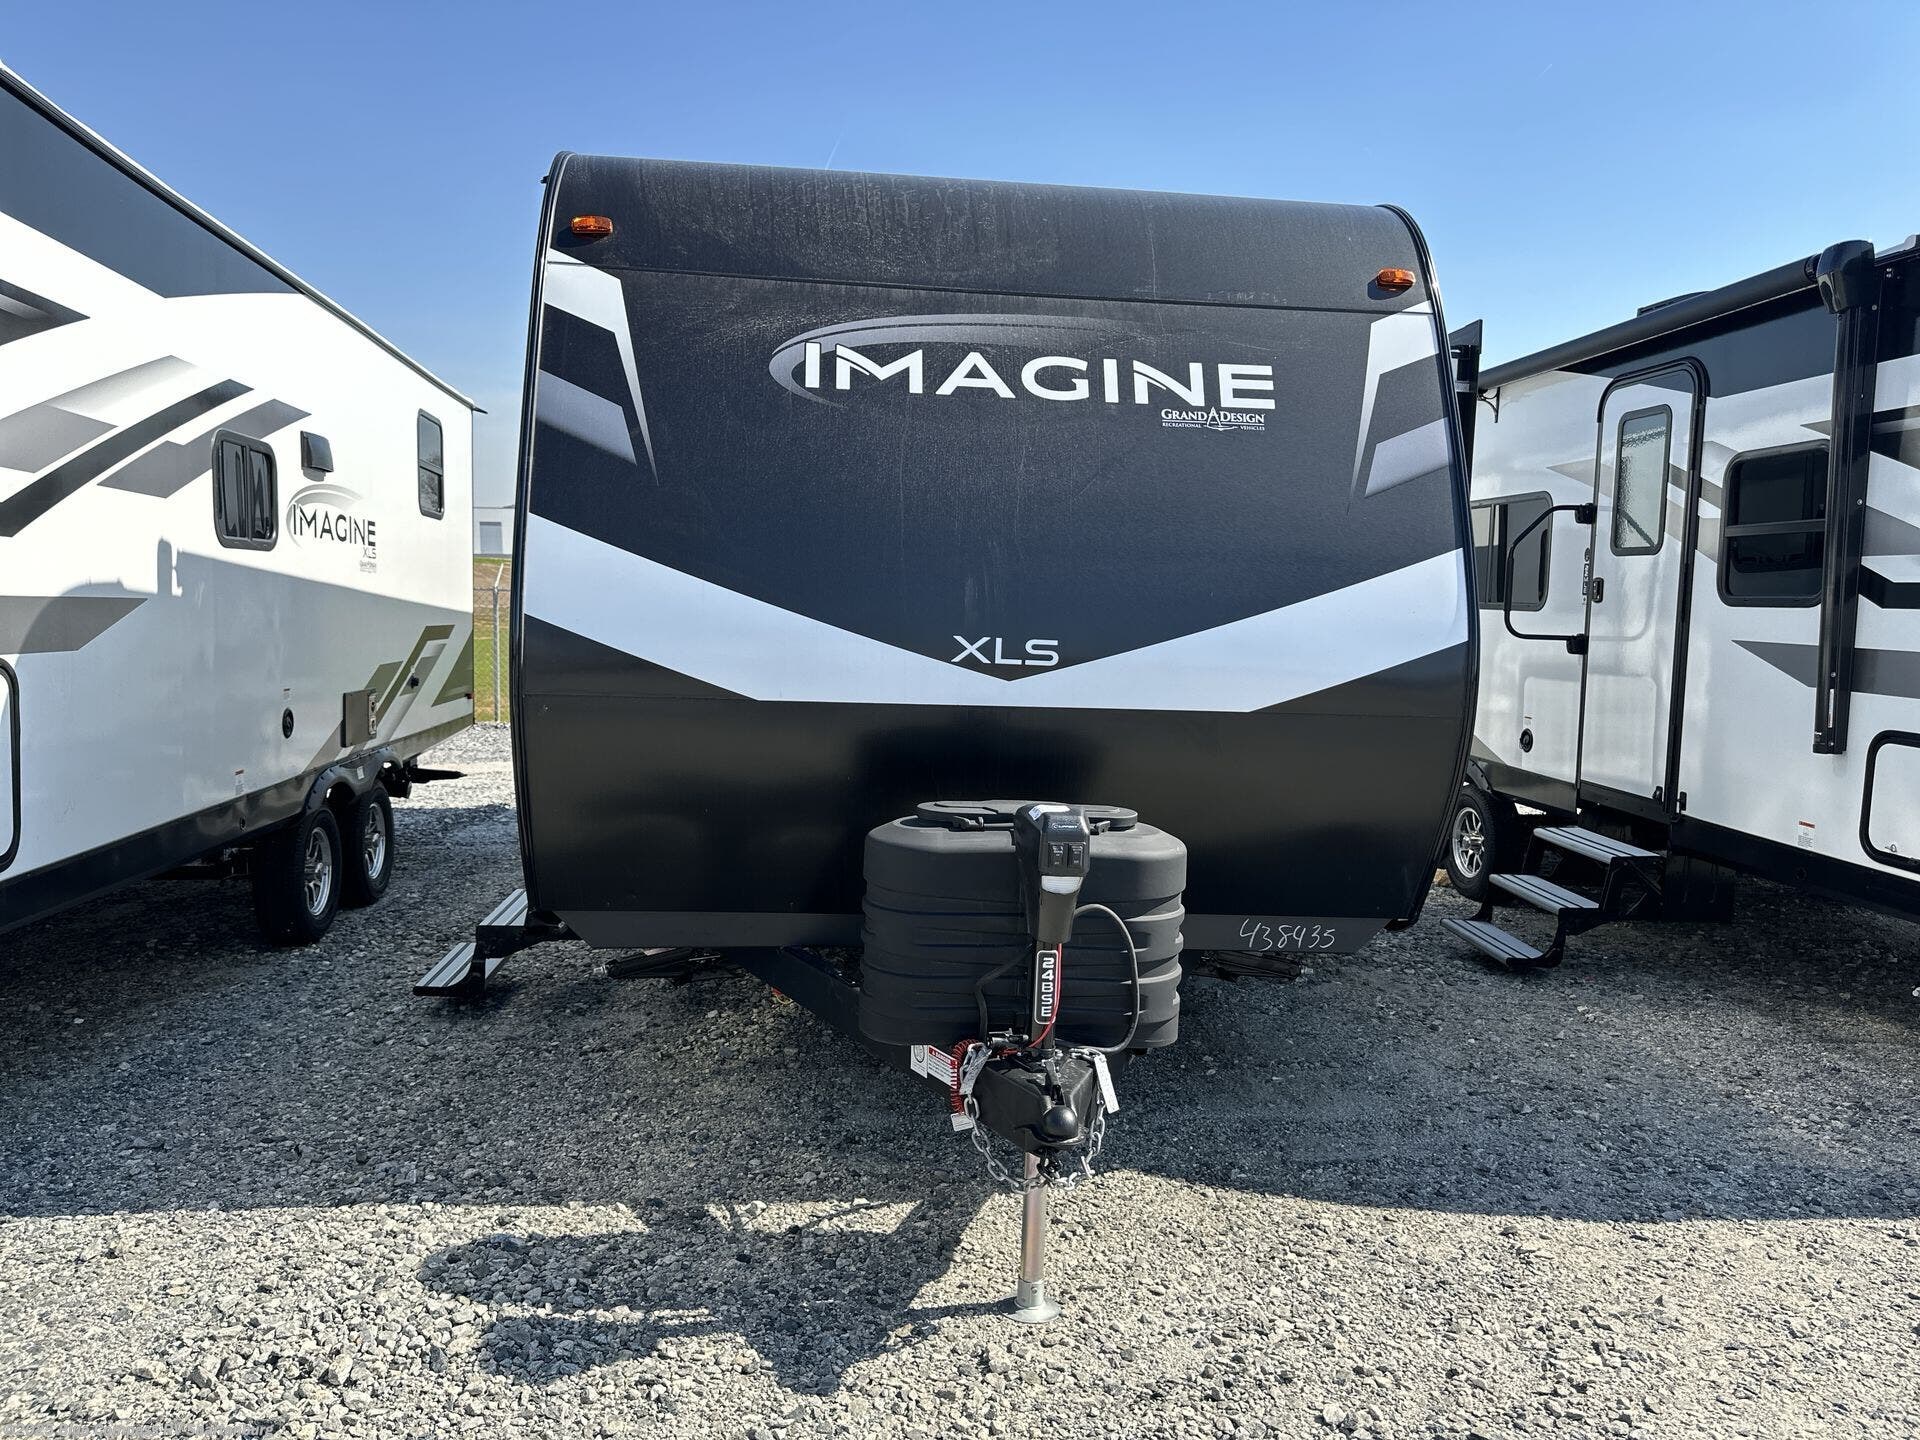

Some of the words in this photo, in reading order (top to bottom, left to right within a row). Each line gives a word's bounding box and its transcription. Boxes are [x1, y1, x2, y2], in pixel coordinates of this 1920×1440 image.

[804, 341, 1276, 410] IMAGINE
[1161, 408, 1208, 421] GRAND
[1219, 410, 1265, 424] DESIGN
[292, 503, 377, 548] IMAGINE
[950, 634, 1060, 667] XLS
[1040, 956, 1056, 1018] 24BSE
